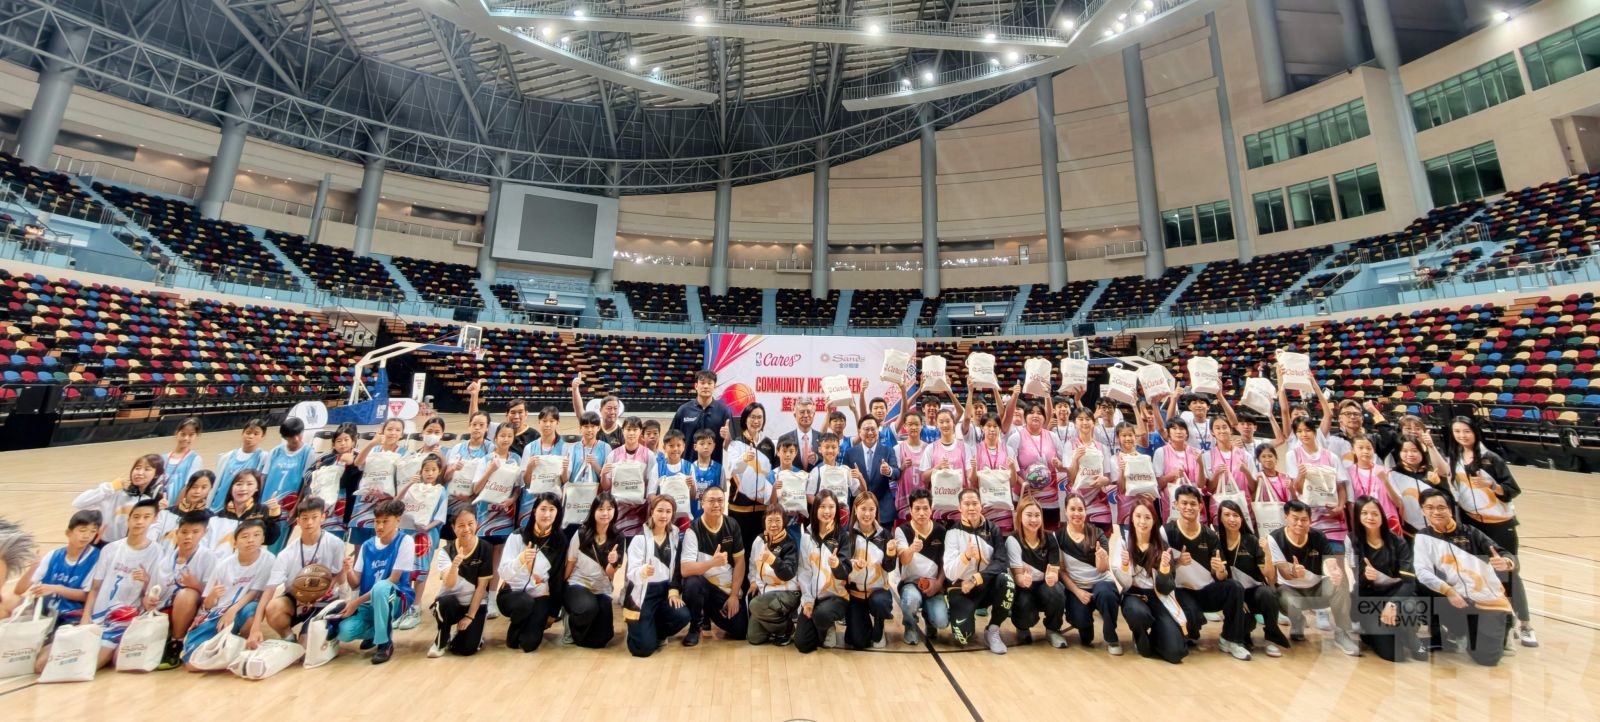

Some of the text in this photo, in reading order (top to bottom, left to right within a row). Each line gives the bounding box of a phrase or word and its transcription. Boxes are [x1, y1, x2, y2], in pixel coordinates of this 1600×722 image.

[763, 353, 796, 367] Cares
[756, 377, 862, 394] COMMUNITY IMP EEK
[280, 471, 289, 491] 7
[912, 467, 919, 486] 5
